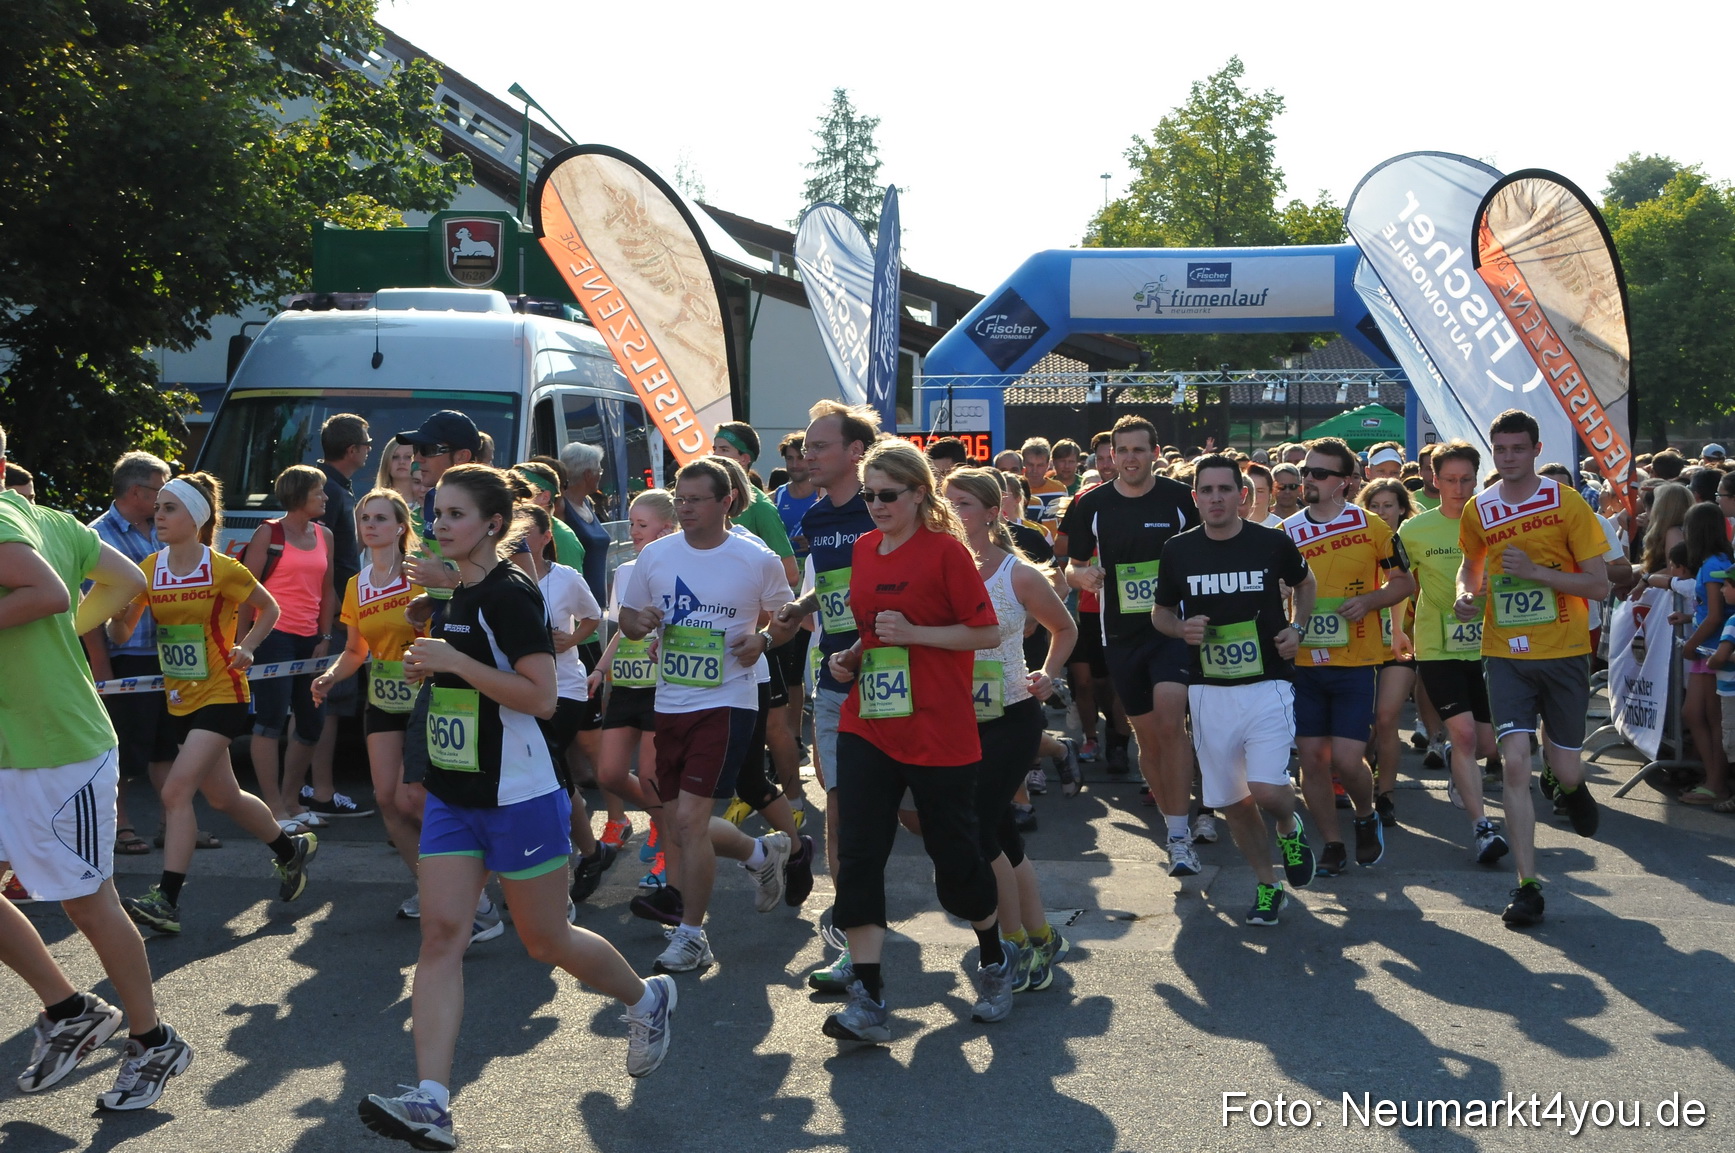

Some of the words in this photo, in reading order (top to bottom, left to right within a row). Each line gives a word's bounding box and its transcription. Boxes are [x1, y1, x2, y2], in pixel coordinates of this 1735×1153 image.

[461, 271, 486, 281] 1628
[1196, 272, 1229, 280] Fischer
[1171, 288, 1269, 307] firmenlauf
[985, 323, 1037, 334] Fischer
[814, 536, 835, 547] EURO
[843, 533, 865, 544] POL
[1486, 526, 1517, 546] MAX
[1522, 513, 1564, 534] BÖGL
[1331, 533, 1372, 551] BÖGL
[1186, 570, 1264, 596] THULE
[152, 593, 177, 604] MAX
[181, 589, 215, 601] BÖGL
[1499, 590, 1546, 614] 792
[359, 605, 380, 620] MAX
[161, 644, 198, 667] 808
[1202, 641, 1258, 666] 1399
[613, 660, 653, 679] 5067
[663, 652, 719, 680] 5078
[374, 678, 412, 701] 835
[859, 671, 908, 702] 1354
[971, 683, 992, 707] 4
[429, 714, 465, 750] 960
